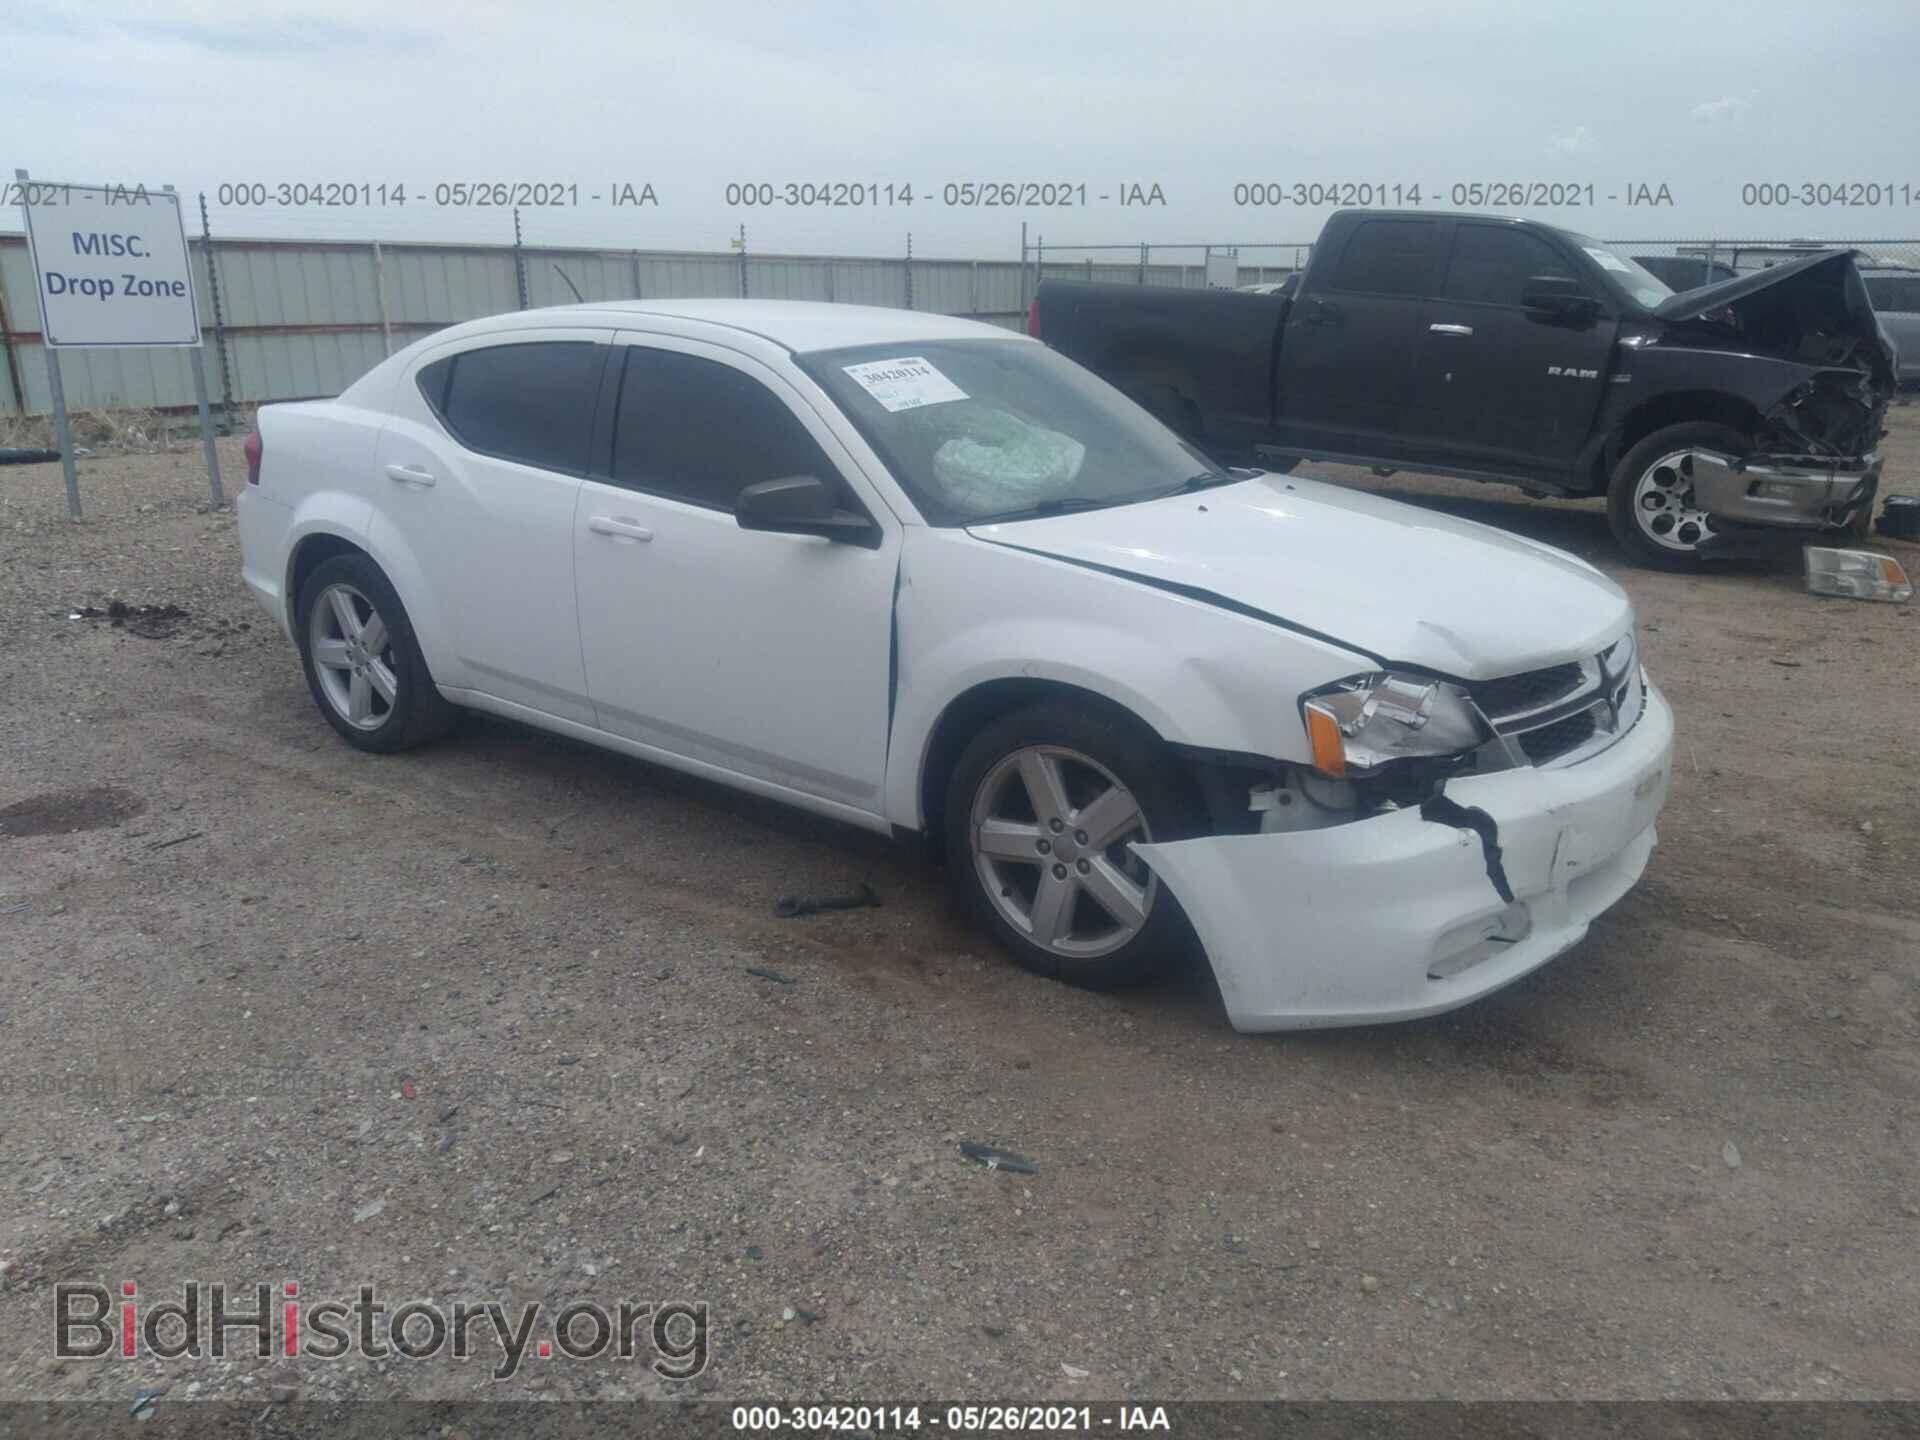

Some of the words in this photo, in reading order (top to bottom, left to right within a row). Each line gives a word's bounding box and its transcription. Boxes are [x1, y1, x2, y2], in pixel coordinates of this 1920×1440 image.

[72, 231, 151, 259] MISC.
[46, 271, 115, 299] Drop
[123, 273, 187, 298] Zone
[1547, 366, 1599, 379] RAM
